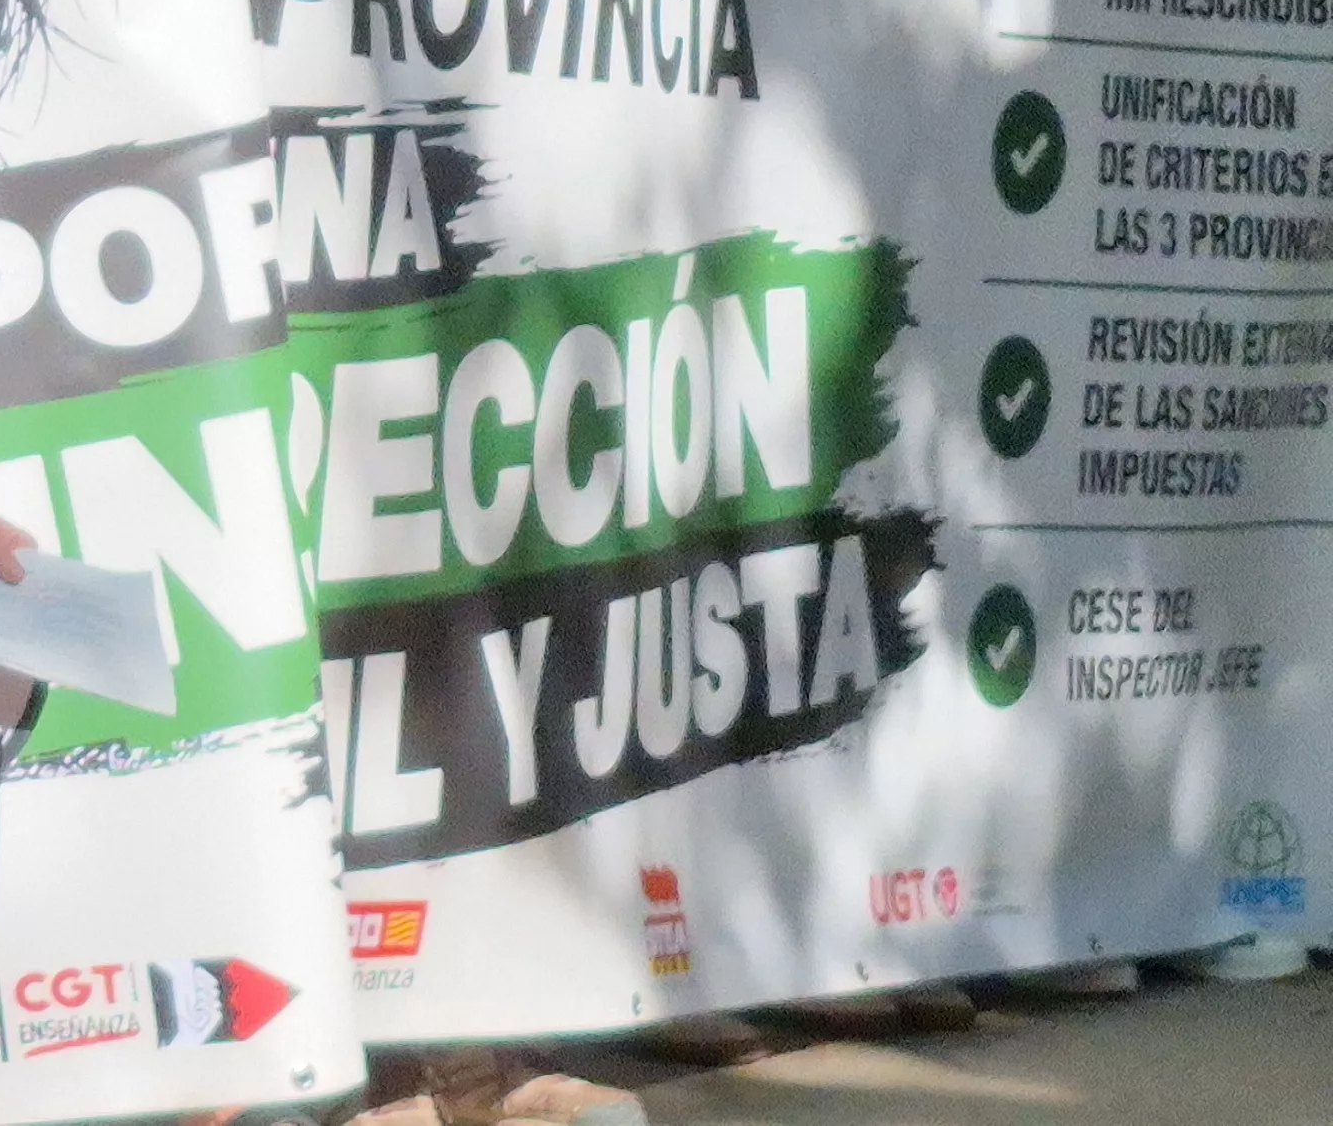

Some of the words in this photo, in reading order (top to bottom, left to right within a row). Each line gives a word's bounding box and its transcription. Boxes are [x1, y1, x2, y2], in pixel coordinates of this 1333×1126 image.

[1101, 74, 1297, 130] UNIFICACIÓN
[1098, 141, 1135, 187] DE
[1145, 142, 1309, 197] CRITERIOS
[1094, 206, 1150, 255] LAS
[1159, 211, 1177, 258] 3
[1087, 306, 1232, 366] REVISIÓN
[1084, 382, 1125, 429] DE
[1136, 384, 1193, 431] LAS
[1078, 449, 1245, 497] IMPUESTAS
[1068, 587, 1143, 635] CESE
[480, 616, 553, 806] Y
[574, 534, 879, 779] JUSTA
[1066, 649, 1204, 702] INSPECTOR
[869, 868, 925, 925] UGT
[16, 964, 123, 1012] CGT
[19, 1013, 141, 1044] ENSEÑANZA
